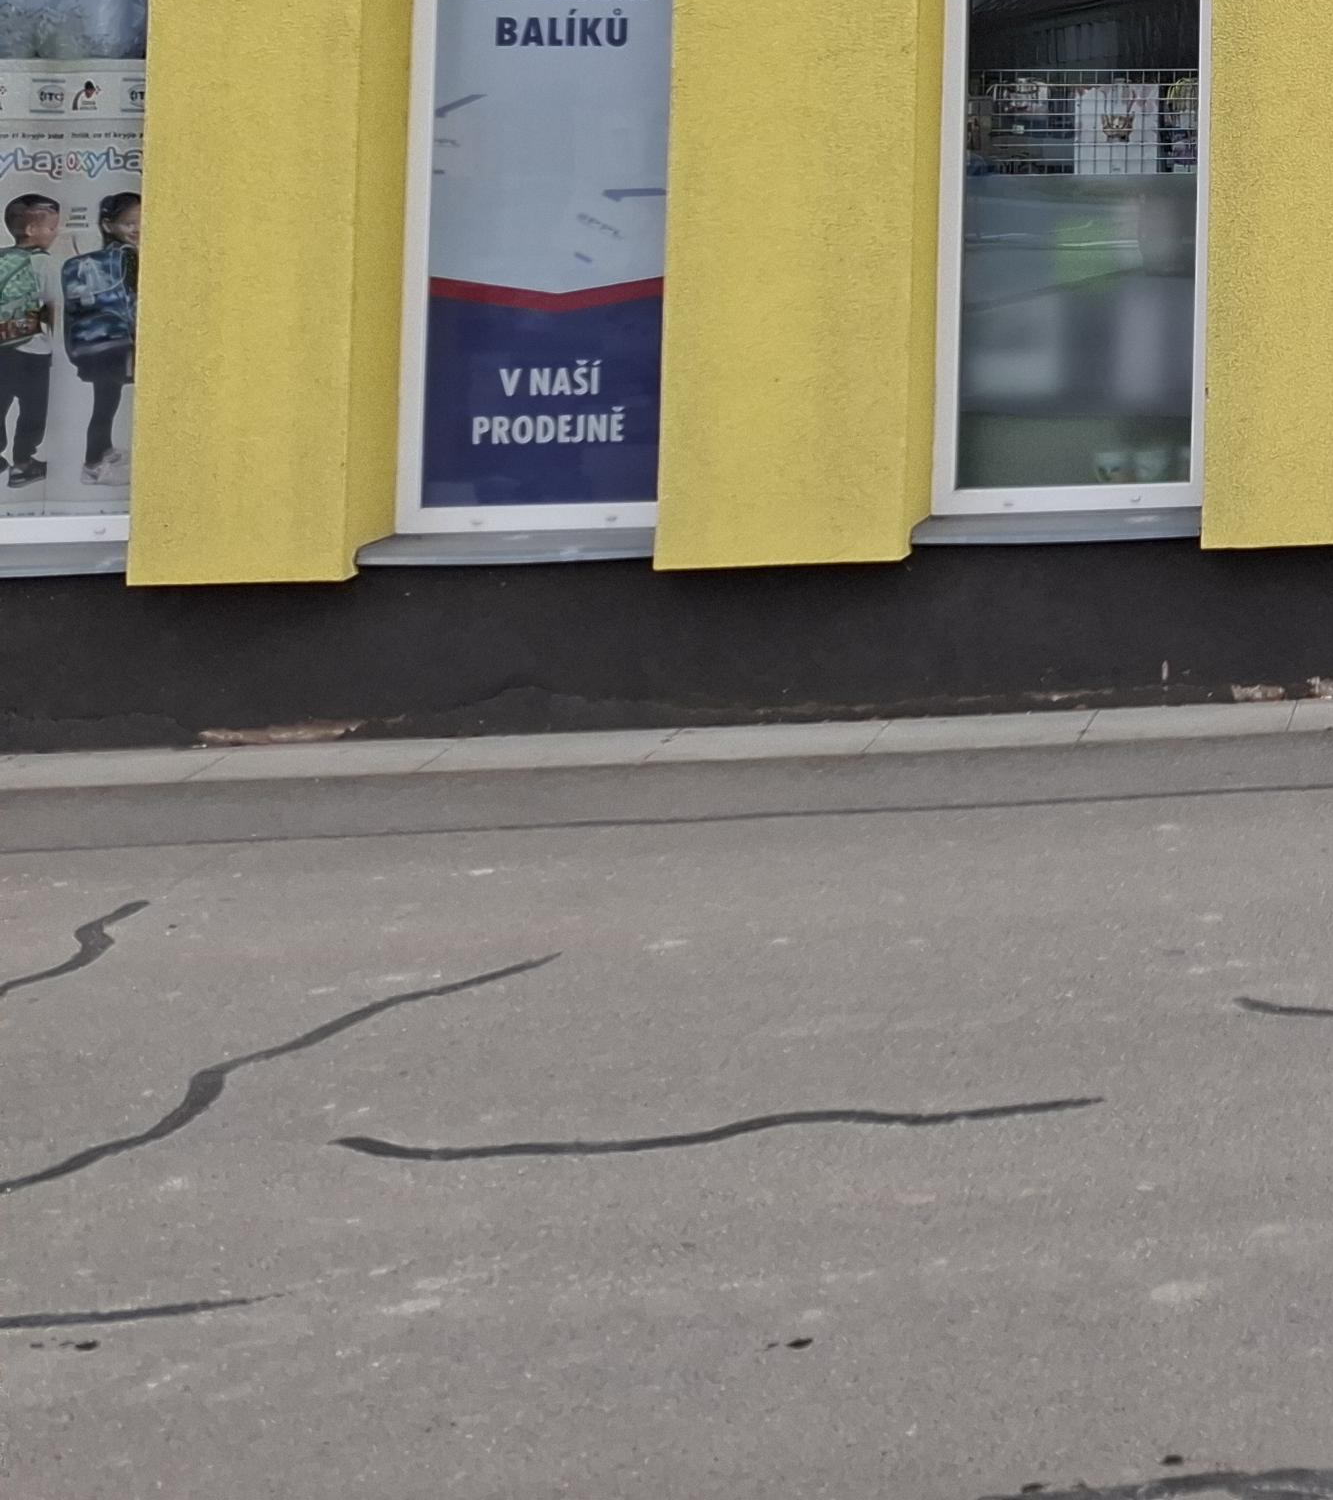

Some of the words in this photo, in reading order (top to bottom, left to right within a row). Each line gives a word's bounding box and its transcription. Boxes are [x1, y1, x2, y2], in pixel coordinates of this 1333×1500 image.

[495, 8, 628, 47] BALÍKŮ
[0, 148, 64, 180] ybag
[66, 147, 143, 178] oxyba
[499, 368, 523, 397] V
[529, 359, 603, 397] NAŠÍ
[472, 406, 626, 445] PRODEJNĚ
